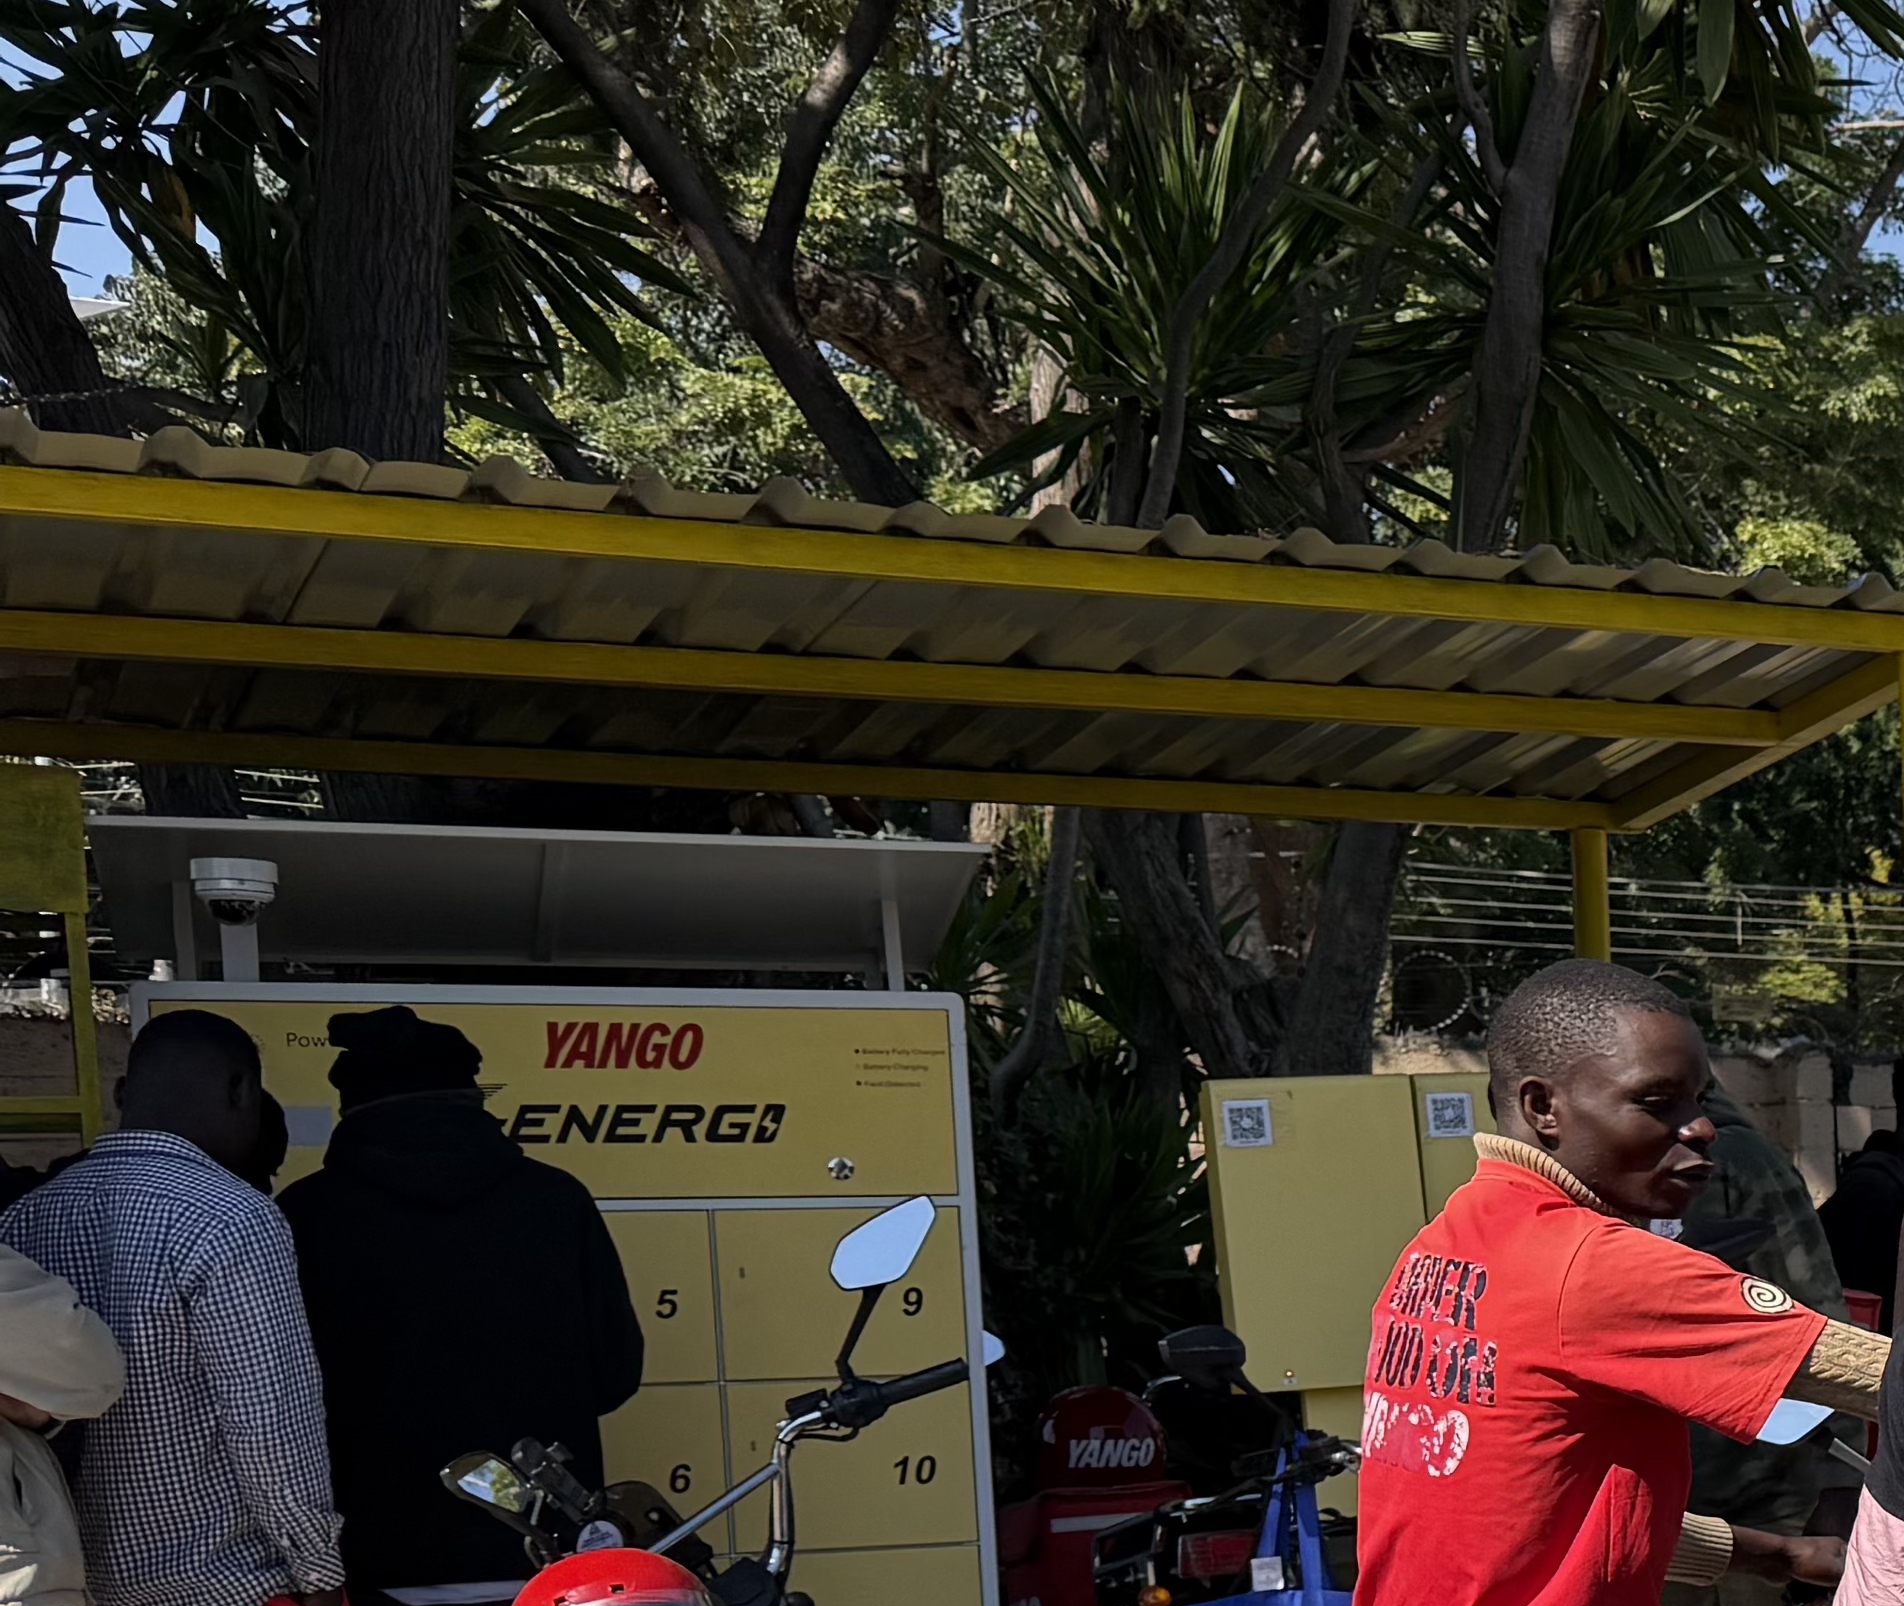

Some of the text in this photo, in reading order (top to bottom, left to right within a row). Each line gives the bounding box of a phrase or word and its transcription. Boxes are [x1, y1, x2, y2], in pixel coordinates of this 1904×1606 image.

[543, 1021, 704, 1071] YANGO
[655, 1289, 678, 1319] 5
[902, 1287, 923, 1317] 9
[1068, 1436, 1155, 1469] YANGO
[670, 1464, 692, 1494] 6
[894, 1455, 937, 1486] 10
